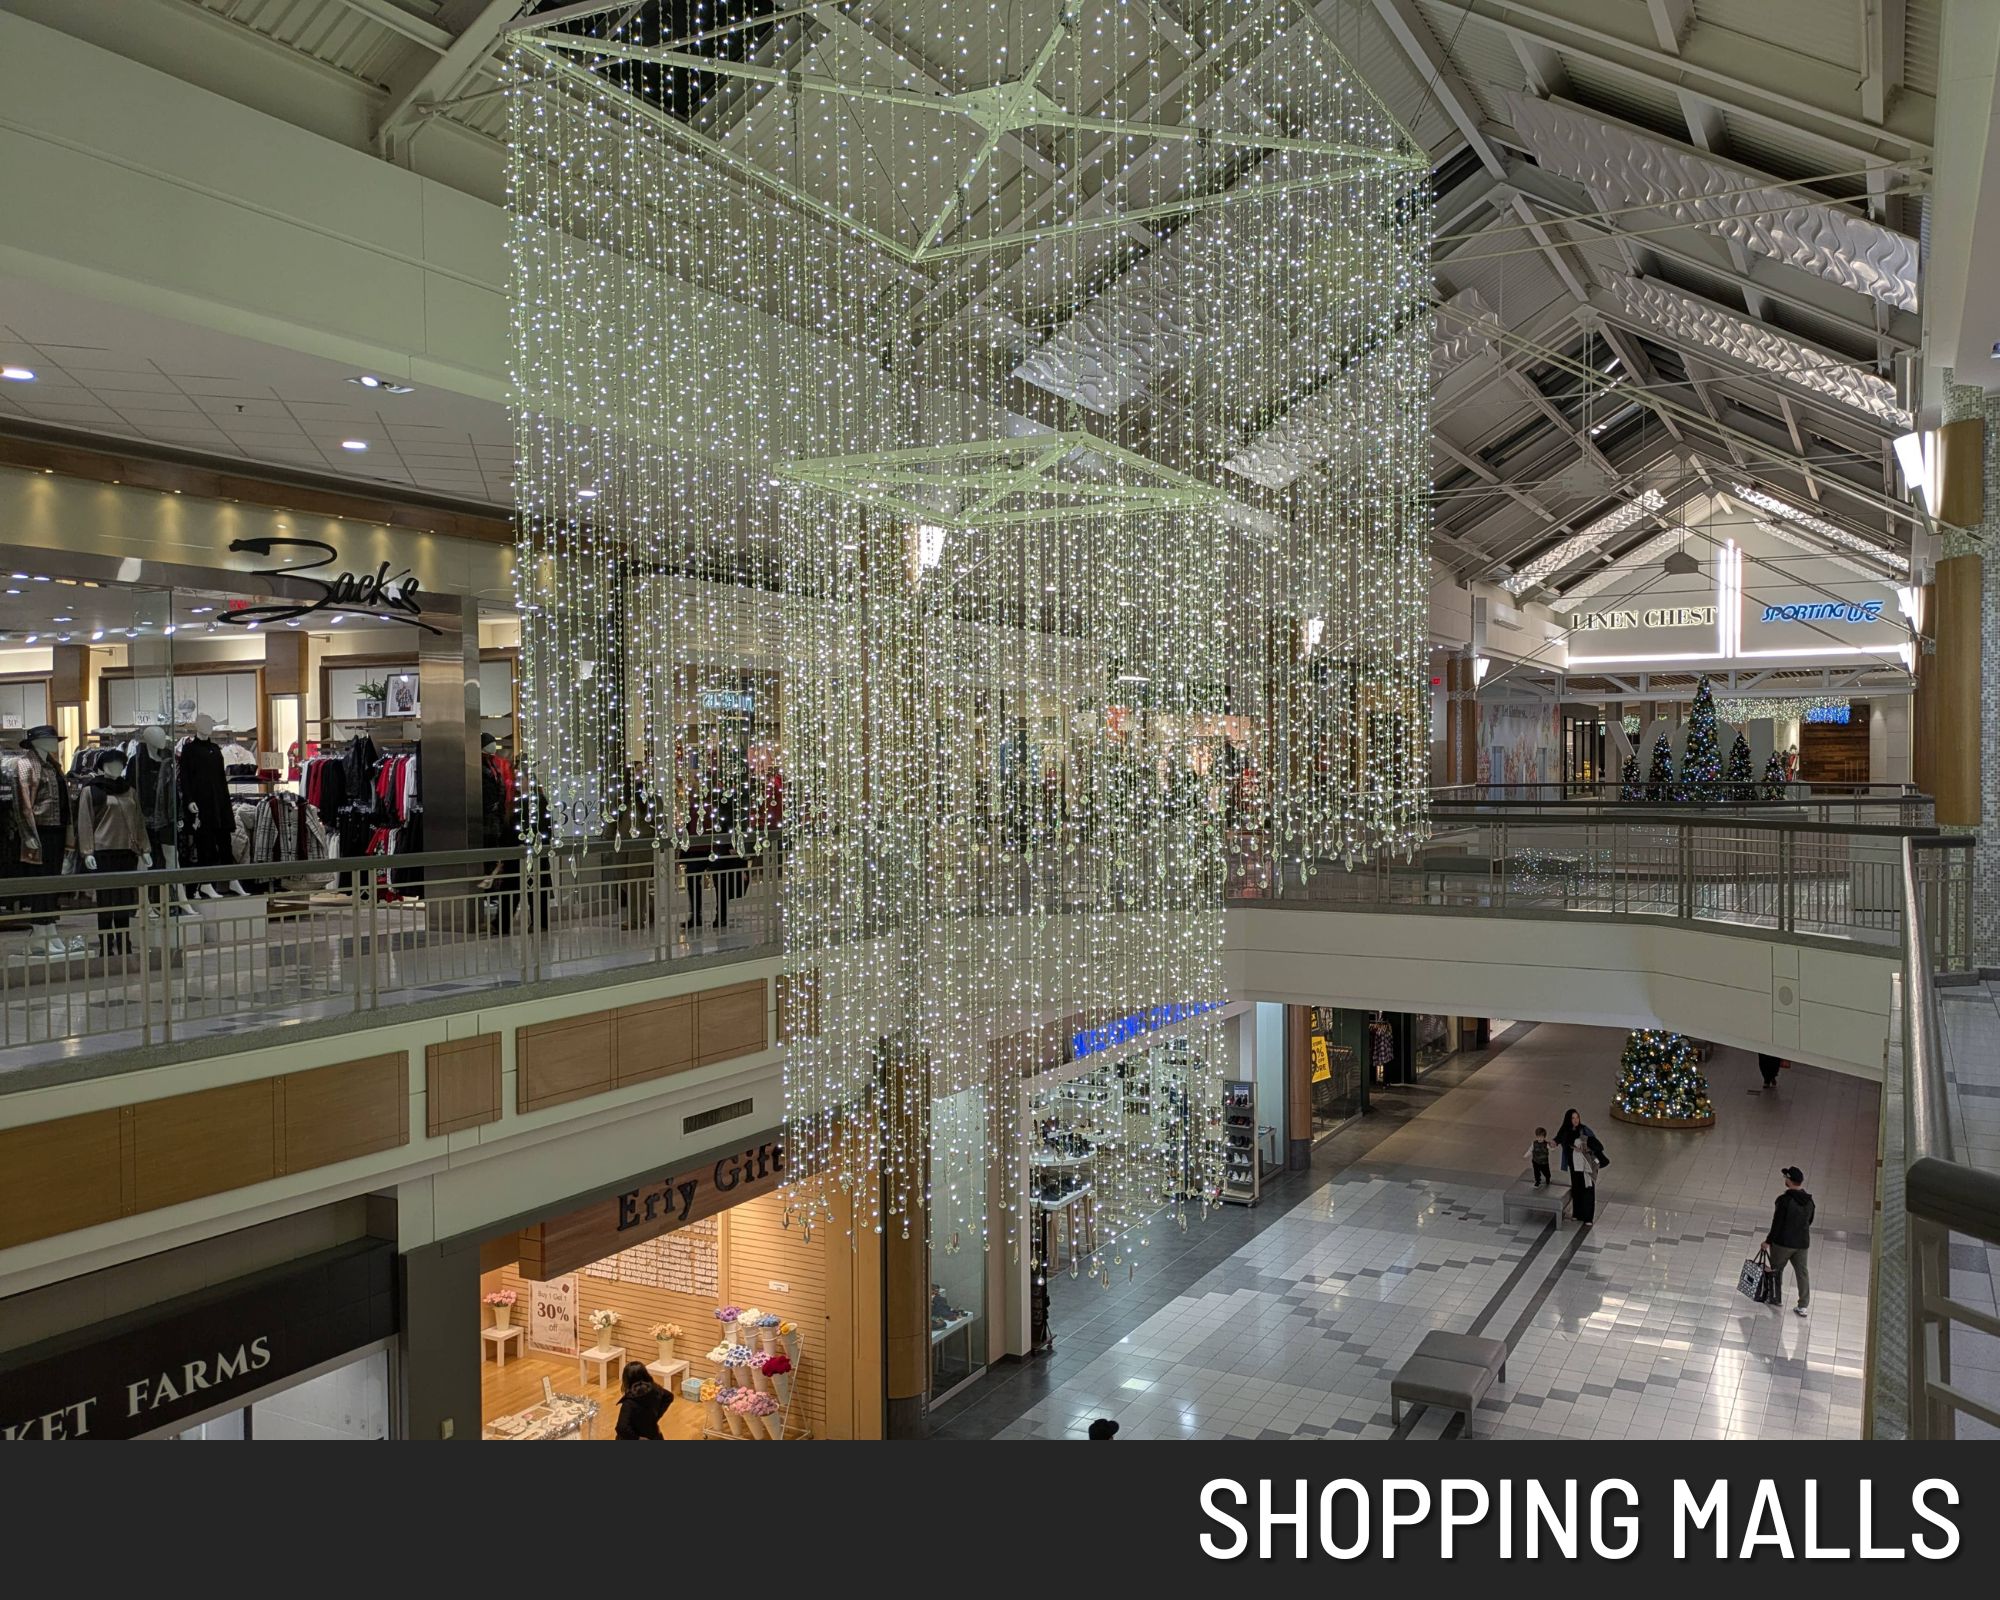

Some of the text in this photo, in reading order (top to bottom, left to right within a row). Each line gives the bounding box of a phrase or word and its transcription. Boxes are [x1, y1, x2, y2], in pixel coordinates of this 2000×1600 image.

[1572, 606, 1717, 631] LINEN CHEST
[713, 1142, 786, 1192] Gift
[537, 1302, 569, 1321] 30%
[126, 1336, 271, 1417] FARMS
